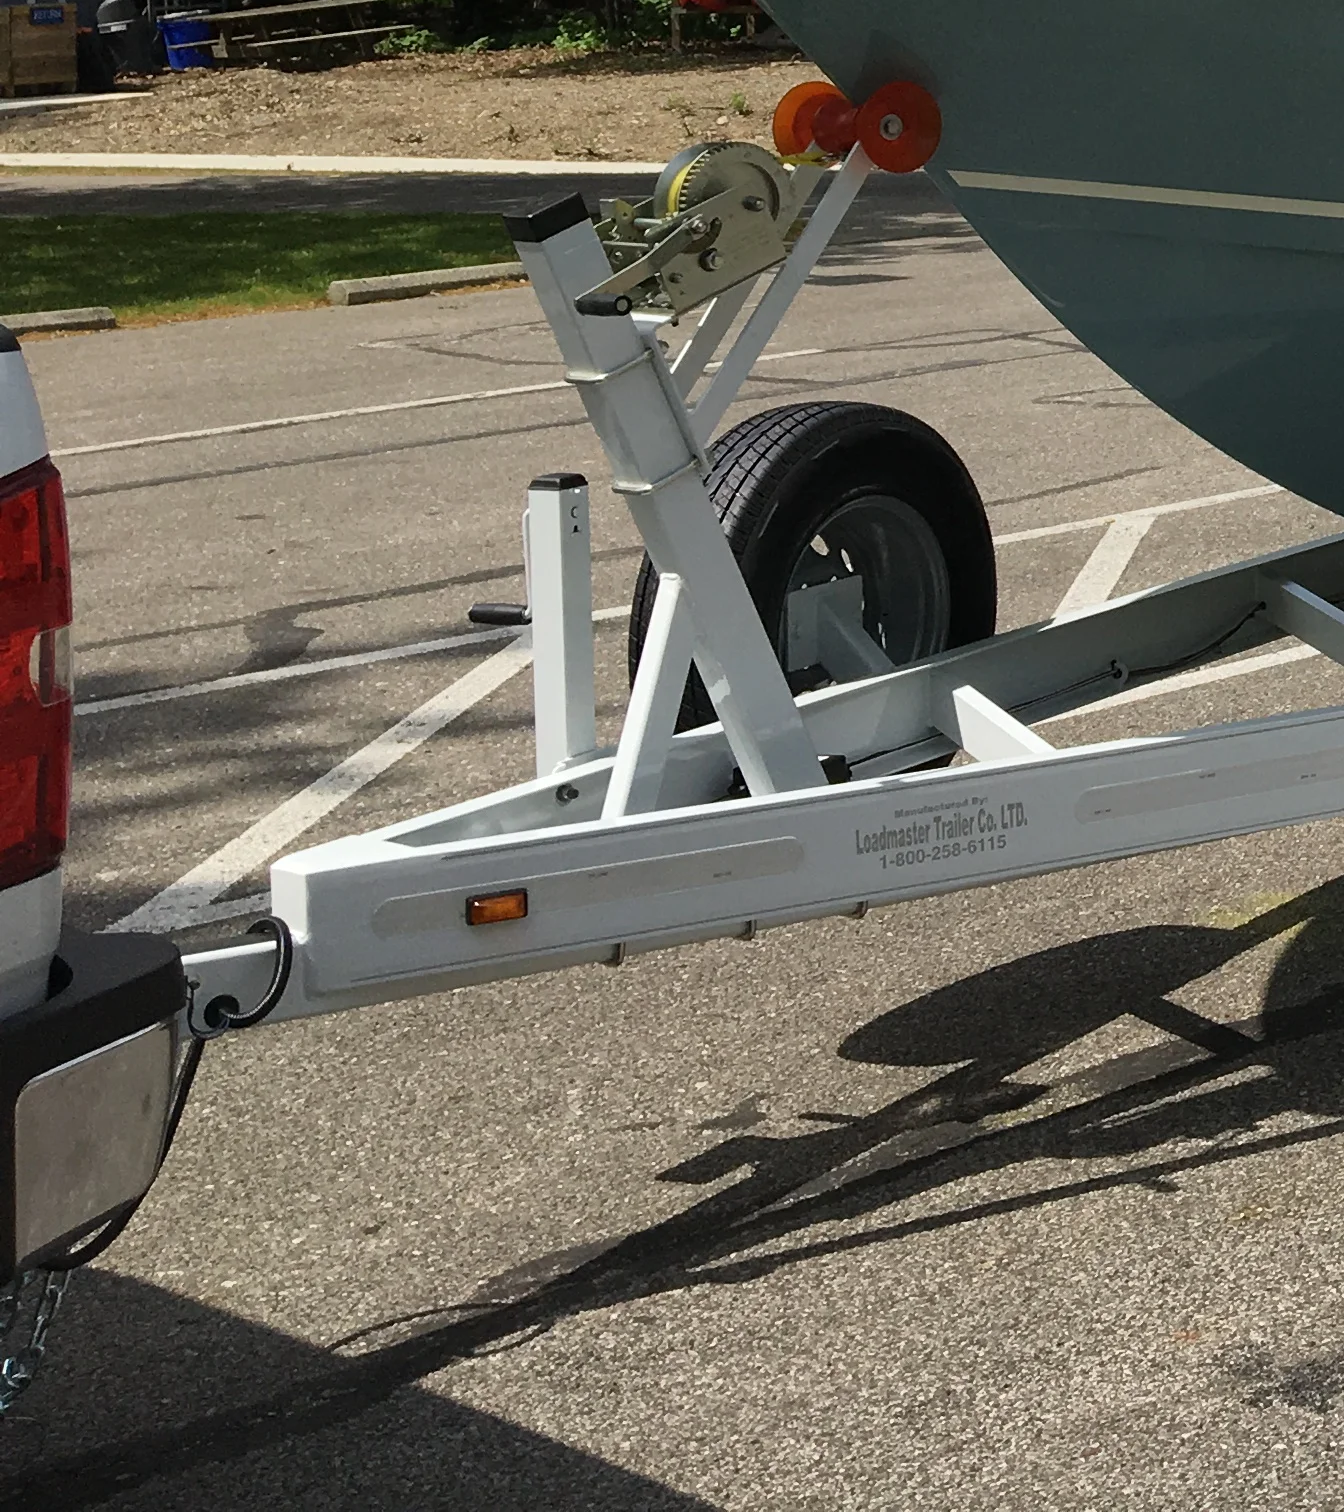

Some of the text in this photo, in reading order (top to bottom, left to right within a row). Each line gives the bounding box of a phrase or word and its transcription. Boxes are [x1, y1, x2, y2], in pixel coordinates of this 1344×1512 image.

[894, 798, 969, 818] Manufactured
[855, 801, 1028, 855] Loadmaster Trailer Co. LTD.
[879, 834, 1007, 869] 1-800-258-6115
